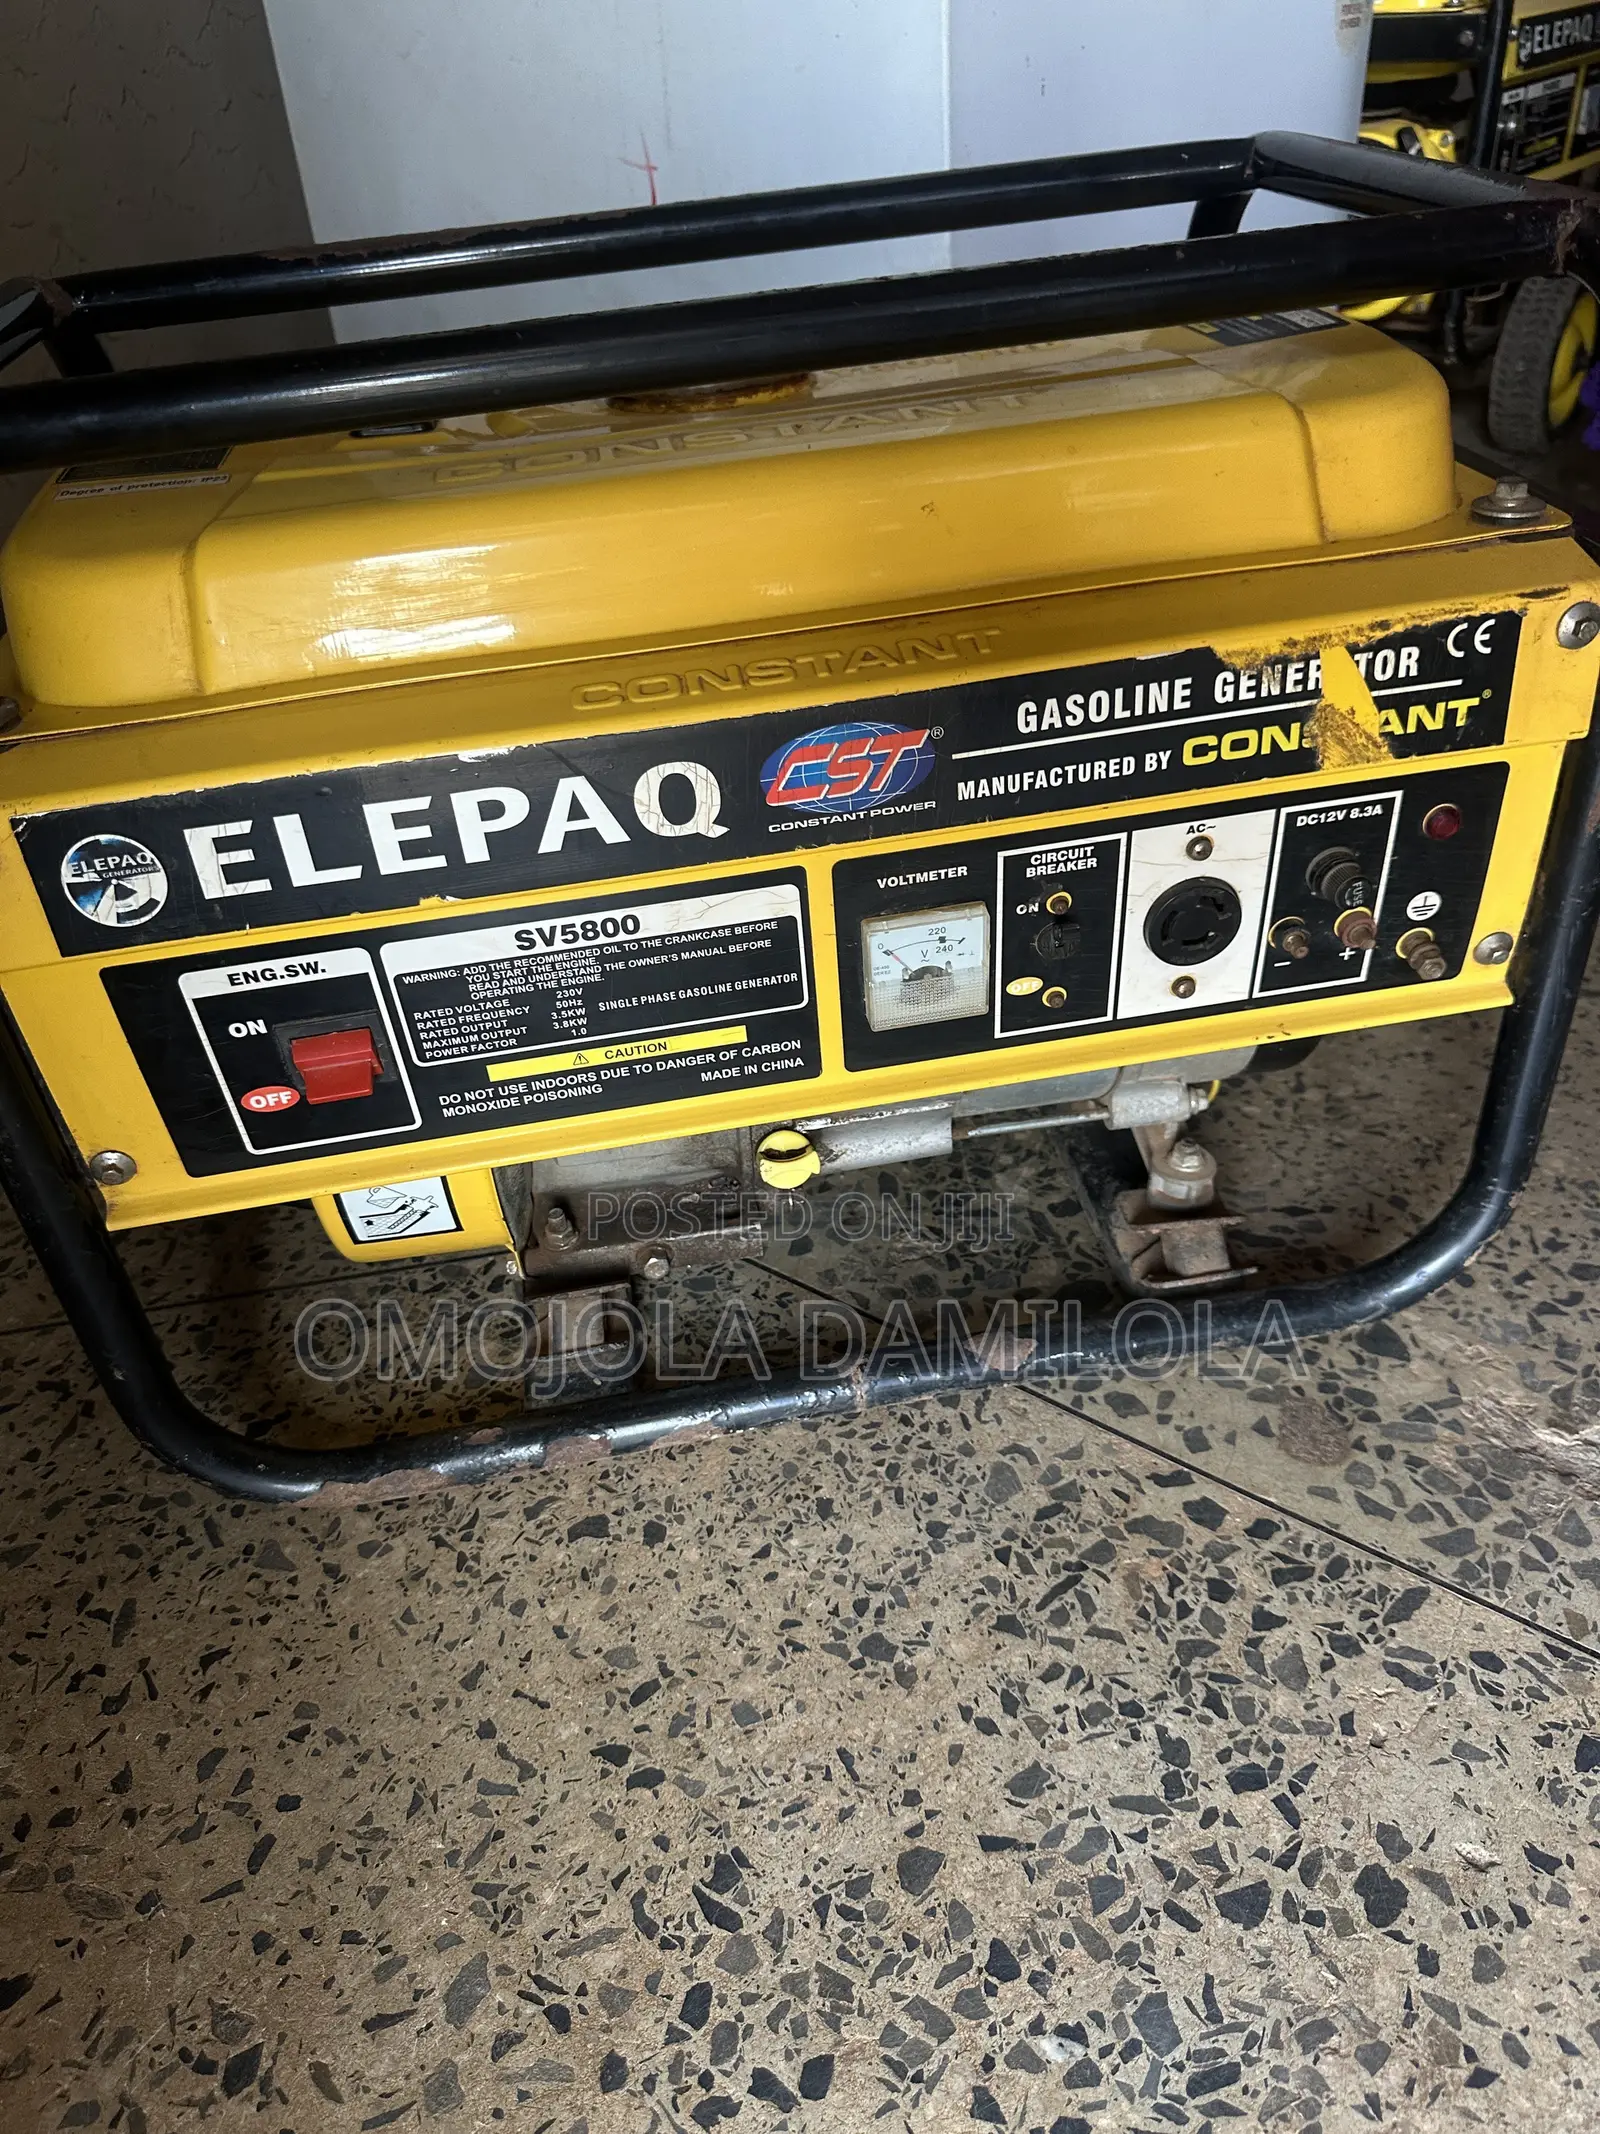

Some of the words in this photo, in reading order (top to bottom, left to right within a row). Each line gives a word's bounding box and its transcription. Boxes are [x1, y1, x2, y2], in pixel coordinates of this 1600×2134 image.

[1533, 14, 1593, 54] ELEPAQ
[433, 391, 1028, 485] CONSTANT
[60, 488, 104, 497] Degree
[127, 479, 196, 491] protection:
[569, 628, 1001, 712] CONSTANT
[1016, 677, 1193, 734] GASOLINE
[1214, 646, 1420, 704] GENERTOR
[957, 755, 1137, 801] MANUFACTURED
[1144, 750, 1172, 772] BY
[1182, 697, 1480, 767] CONANT
[1296, 809, 1347, 828] DC12V
[1350, 804, 1384, 820] 8.3A
[182, 761, 731, 902] ELEPAQ
[71, 852, 153, 874] ELEPAQ
[1026, 858, 1098, 878] BREAKER
[1030, 846, 1094, 865] CIRCUIT
[102, 865, 160, 879] GENERATORS
[876, 866, 968, 889] VOLTMETER
[1352, 881, 1363, 907] FUSE
[1016, 903, 1039, 915] ON
[514, 914, 641, 951] SV5800
[928, 927, 946, 935] 220
[402, 969, 461, 985] WARNING:
[463, 965, 487, 976] ADD
[489, 962, 511, 972] THE
[514, 948, 600, 970] RECOMMENDED
[603, 943, 621, 954] OIL
[623, 942, 638, 951] TO
[641, 939, 662, 949] THE
[665, 928, 732, 945] CRANKCASE
[735, 921, 778, 935] BEFORE
[936, 945, 953, 953] 240
[227, 961, 327, 987] ENG.SW.
[466, 973, 490, 984] YOU
[493, 968, 528, 980] START
[531, 964, 553, 974] THE
[555, 958, 599, 972] ENGINE.
[469, 981, 500, 992] READ
[502, 977, 526, 988] AND
[528, 965, 602, 984] UNDERSTAND
[604, 962, 626, 972] THE
[628, 954, 679, 968] OWNER'S
[681, 947, 726, 961] MANUAL
[729, 939, 772, 953] BEFORE
[471, 984, 535, 1001] OPERATING
[537, 980, 559, 991] THE
[561, 974, 605, 988] ENGINE.
[599, 997, 639, 1012] SINGLE
[641, 991, 677, 1005] PHASE
[679, 983, 733, 999] GASOLINE
[735, 973, 798, 990] GENERATOR
[1010, 980, 1039, 993] OFF
[414, 1007, 453, 1021] RATED
[455, 999, 510, 1014] VOLTAGE
[556, 988, 583, 999] 230V
[417, 1018, 456, 1031] RATED
[458, 1006, 530, 1024] FREQUENCY
[556, 999, 583, 1009] 50Hz
[228, 1019, 268, 1038] ON
[420, 1028, 459, 1041] RATED
[461, 1020, 508, 1034] OUTPUT
[551, 1008, 586, 1020] 3.5KW
[423, 1035, 479, 1050] MAXIMUM
[481, 1027, 528, 1041] OUTPUT
[553, 1018, 588, 1030] 3.8KW
[426, 1046, 469, 1059] POWER
[471, 1038, 518, 1052] FACTOR
[571, 1028, 587, 1037] 1.0
[604, 1041, 668, 1060] CAUTION
[438, 1094, 462, 1106] DO
[465, 1090, 496, 1103] NOT
[499, 1084, 529, 1098] USE
[531, 1072, 597, 1093] INDOORS
[600, 1067, 630, 1081] DUE
[633, 1063, 653, 1075] TO
[656, 1055, 716, 1073] DANGER
[719, 1050, 739, 1062] OF
[742, 1040, 802, 1059] CARBON
[701, 1067, 741, 1083] MADE
[744, 1064, 759, 1075] IN
[762, 1057, 804, 1073] CHINA
[249, 1091, 292, 1109] OFF
[442, 1097, 521, 1118] MONOXIDE
[523, 1084, 603, 1105] POISONING
